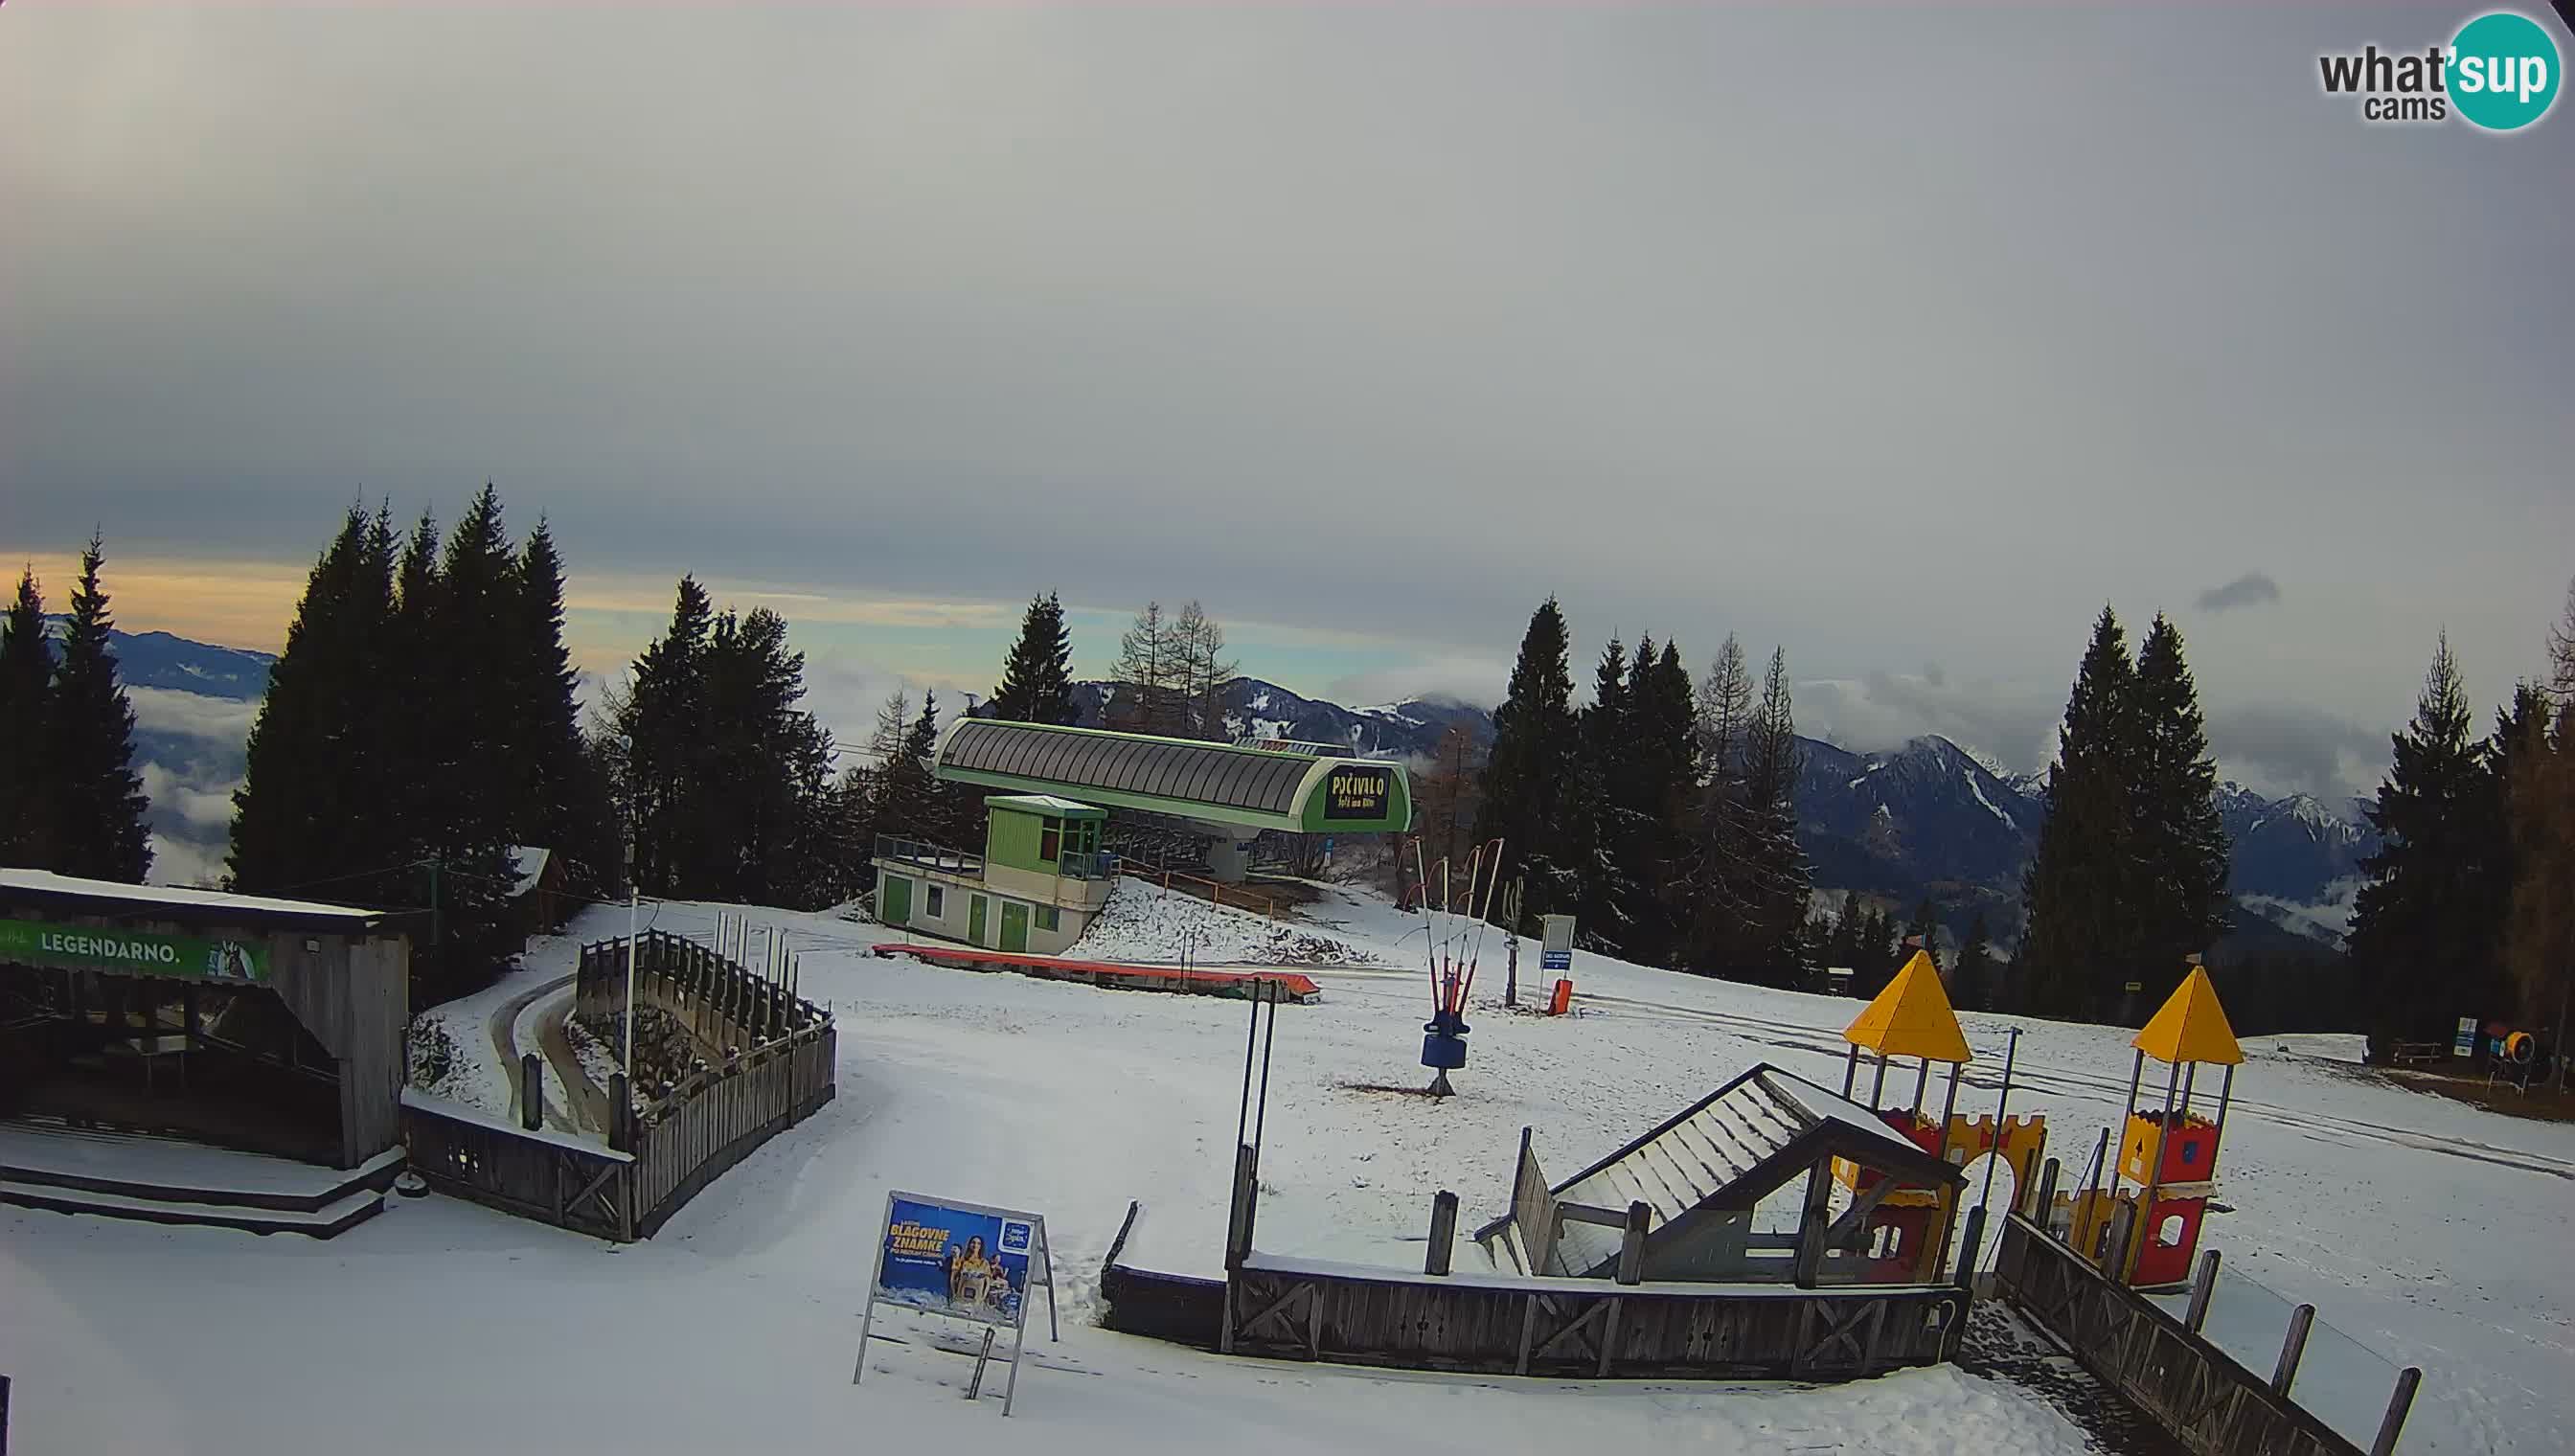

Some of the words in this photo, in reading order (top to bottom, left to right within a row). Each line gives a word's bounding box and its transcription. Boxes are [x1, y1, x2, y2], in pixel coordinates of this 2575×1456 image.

[41, 932, 181, 964] LEGENDARNO.
[890, 1224, 950, 1241] BLAGOVNE
[893, 1237, 944, 1252] ZNAMKE
